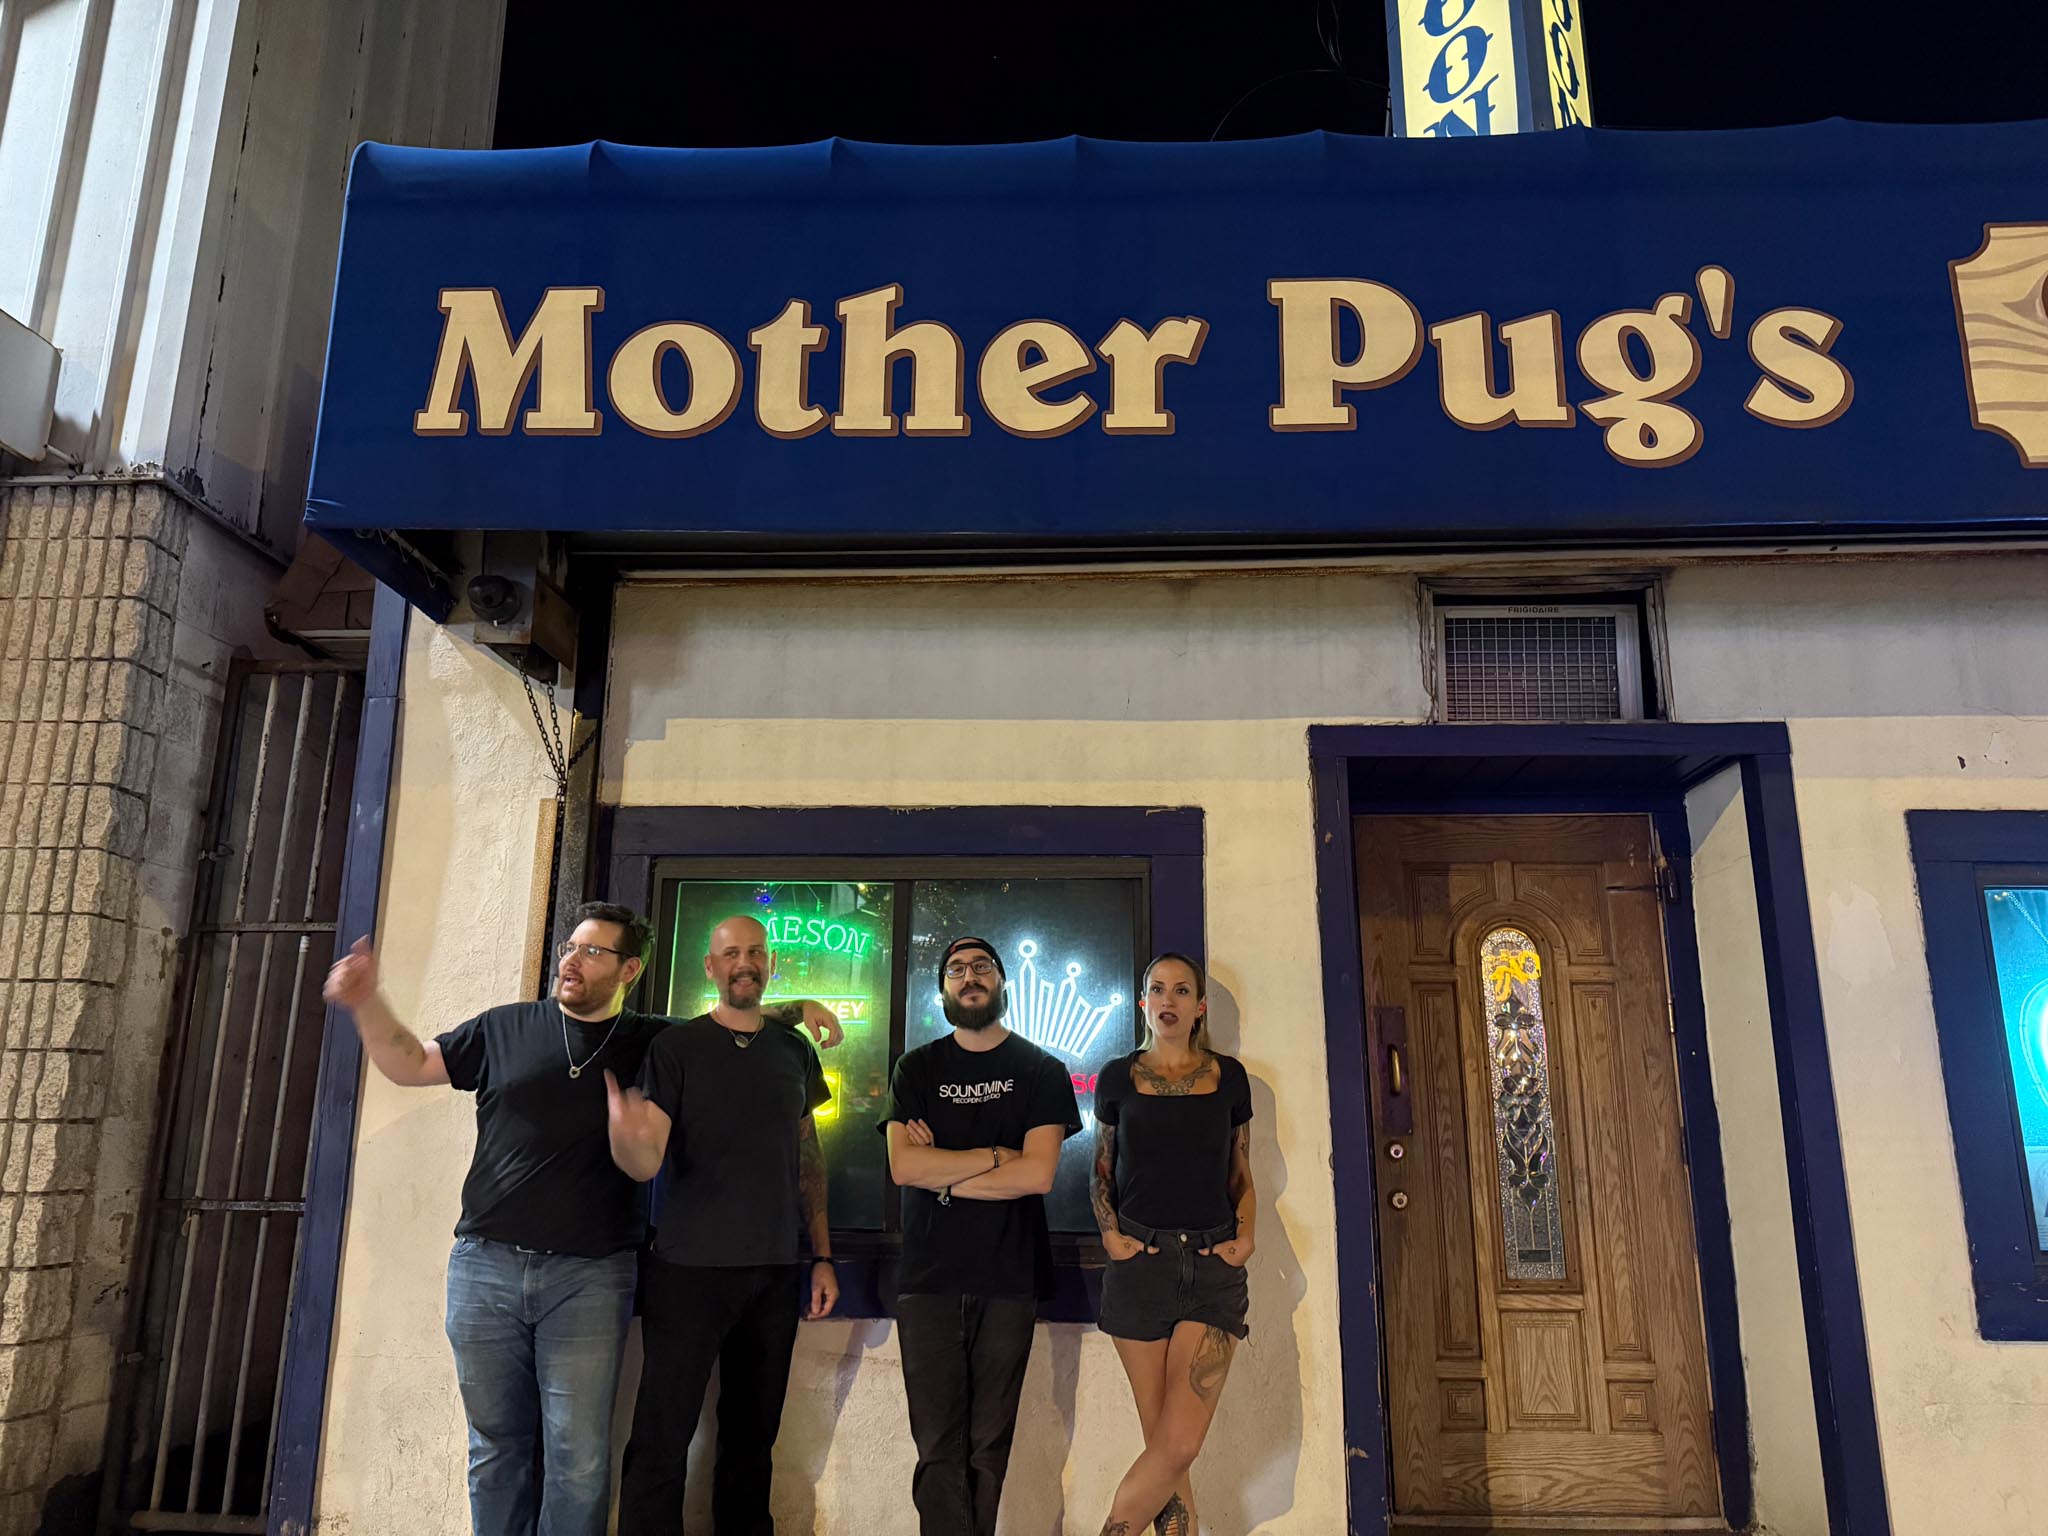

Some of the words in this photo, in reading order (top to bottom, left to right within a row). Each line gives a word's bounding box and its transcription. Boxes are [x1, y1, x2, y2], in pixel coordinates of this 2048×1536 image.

[413, 282, 1209, 439] Mother
[1267, 265, 1853, 468] Pug's
[1507, 606, 1560, 614] FRIGIDAIRE
[766, 915, 871, 958] ESON
[939, 1079, 1014, 1097] SOUNDMINE
